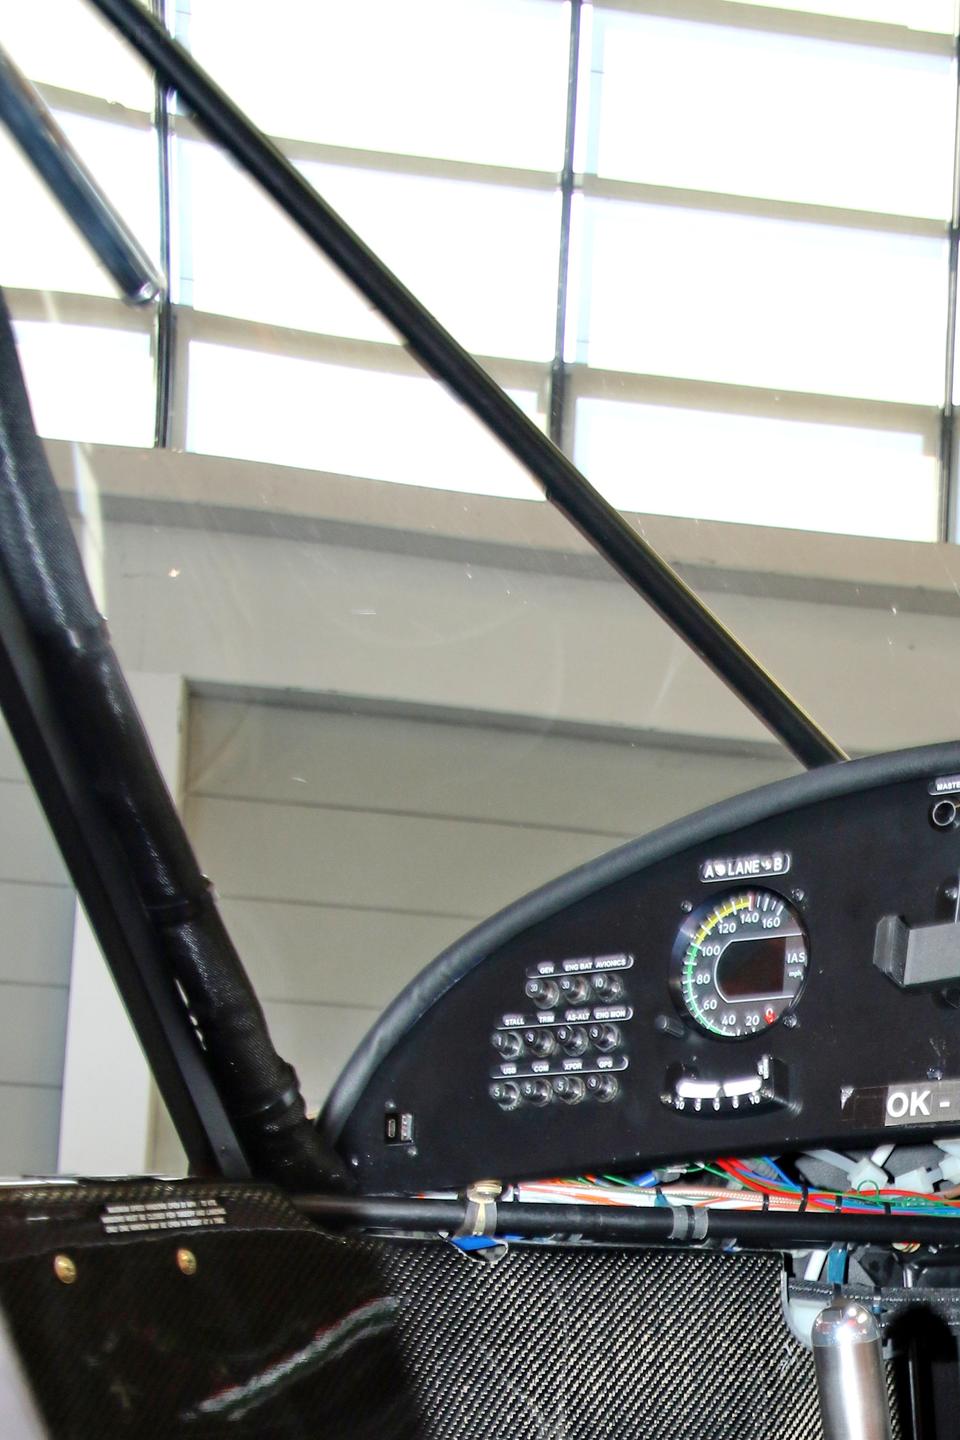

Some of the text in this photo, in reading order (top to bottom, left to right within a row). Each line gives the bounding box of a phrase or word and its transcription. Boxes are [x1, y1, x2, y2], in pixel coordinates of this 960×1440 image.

[705, 857, 783, 878] A LANE B
[740, 913, 760, 924] 140
[762, 917, 780, 928] 160
[718, 922, 736, 934] 120
[702, 946, 721, 957] 100
[787, 952, 805, 964] IAS
[696, 974, 710, 984] 80
[703, 999, 717, 1010] 60
[722, 1014, 736, 1025] 40
[746, 1015, 760, 1026] 20
[886, 1089, 931, 1118] OK
